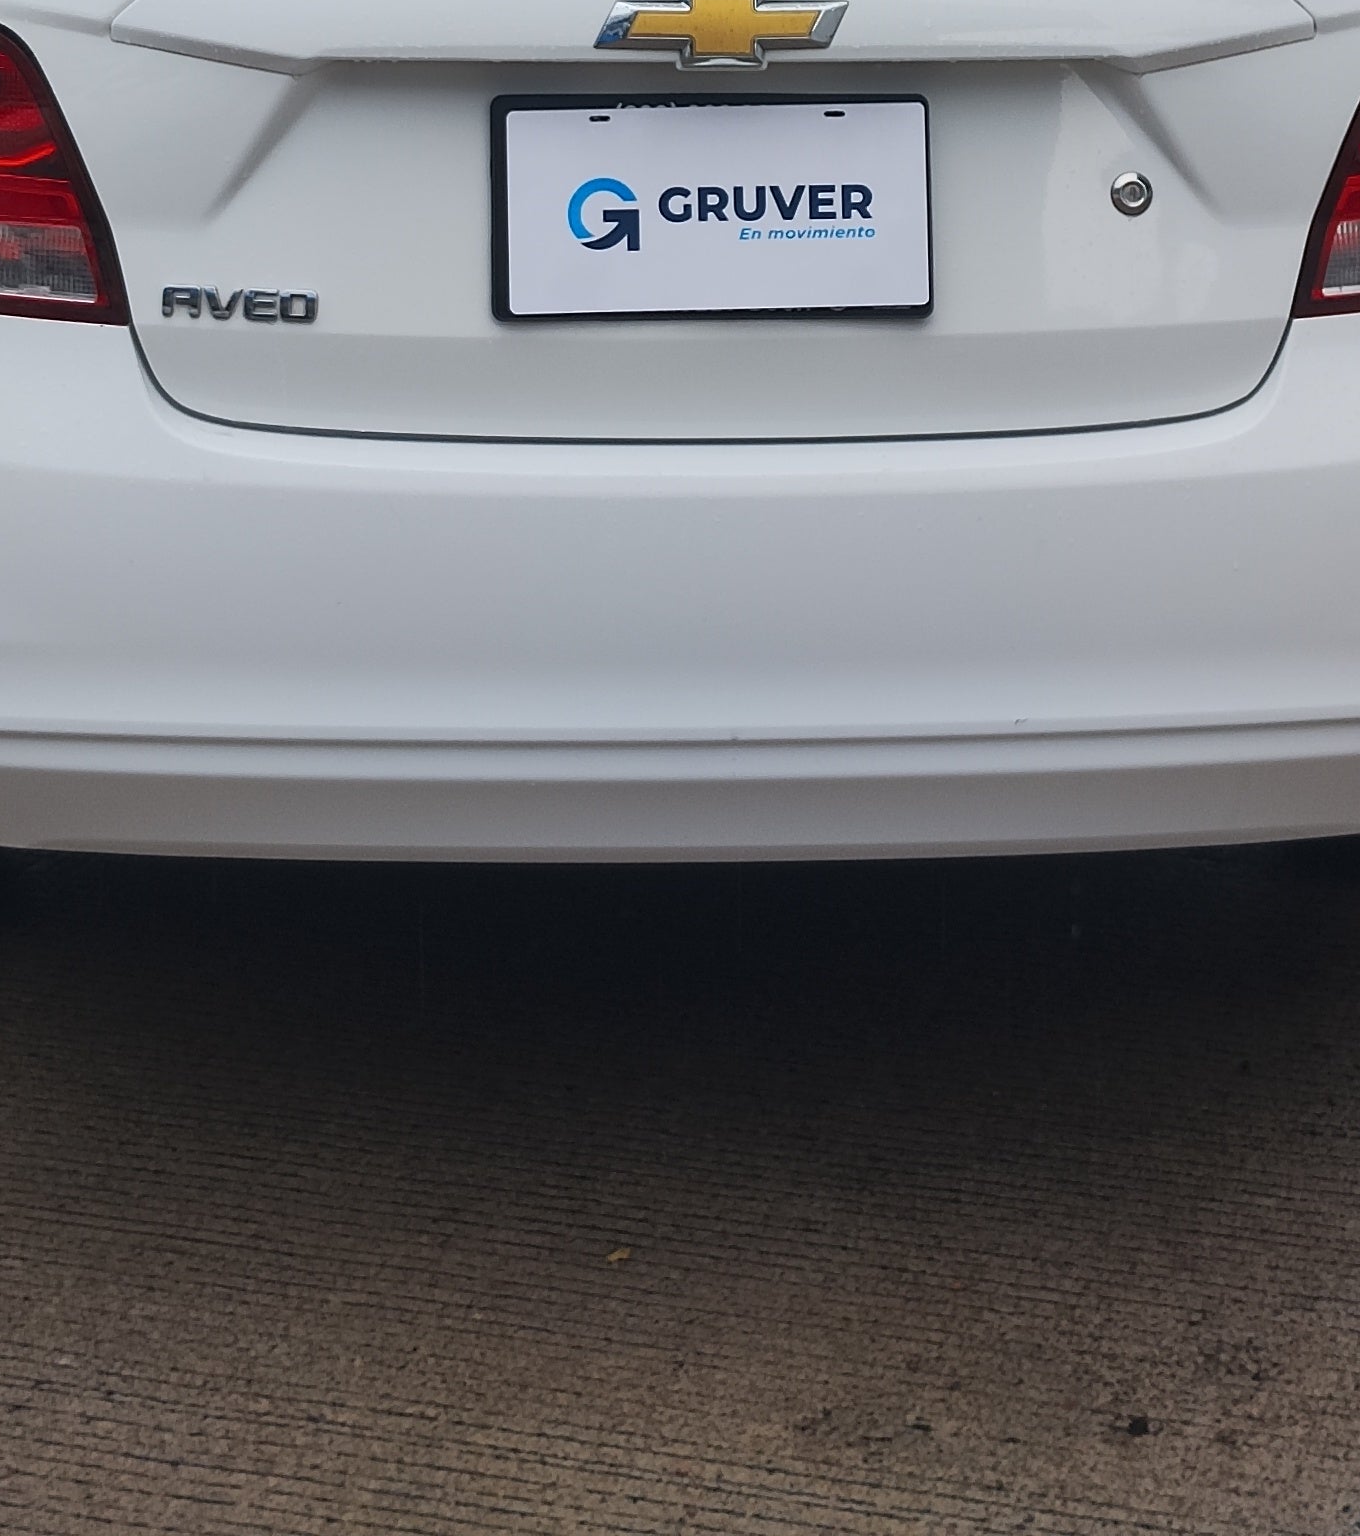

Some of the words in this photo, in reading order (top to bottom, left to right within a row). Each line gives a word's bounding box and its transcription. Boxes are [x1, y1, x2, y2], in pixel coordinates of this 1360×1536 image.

[658, 184, 873, 223] GRUVER
[739, 228, 762, 241] En
[768, 226, 876, 241] movimiento
[162, 284, 319, 324] AVEO
